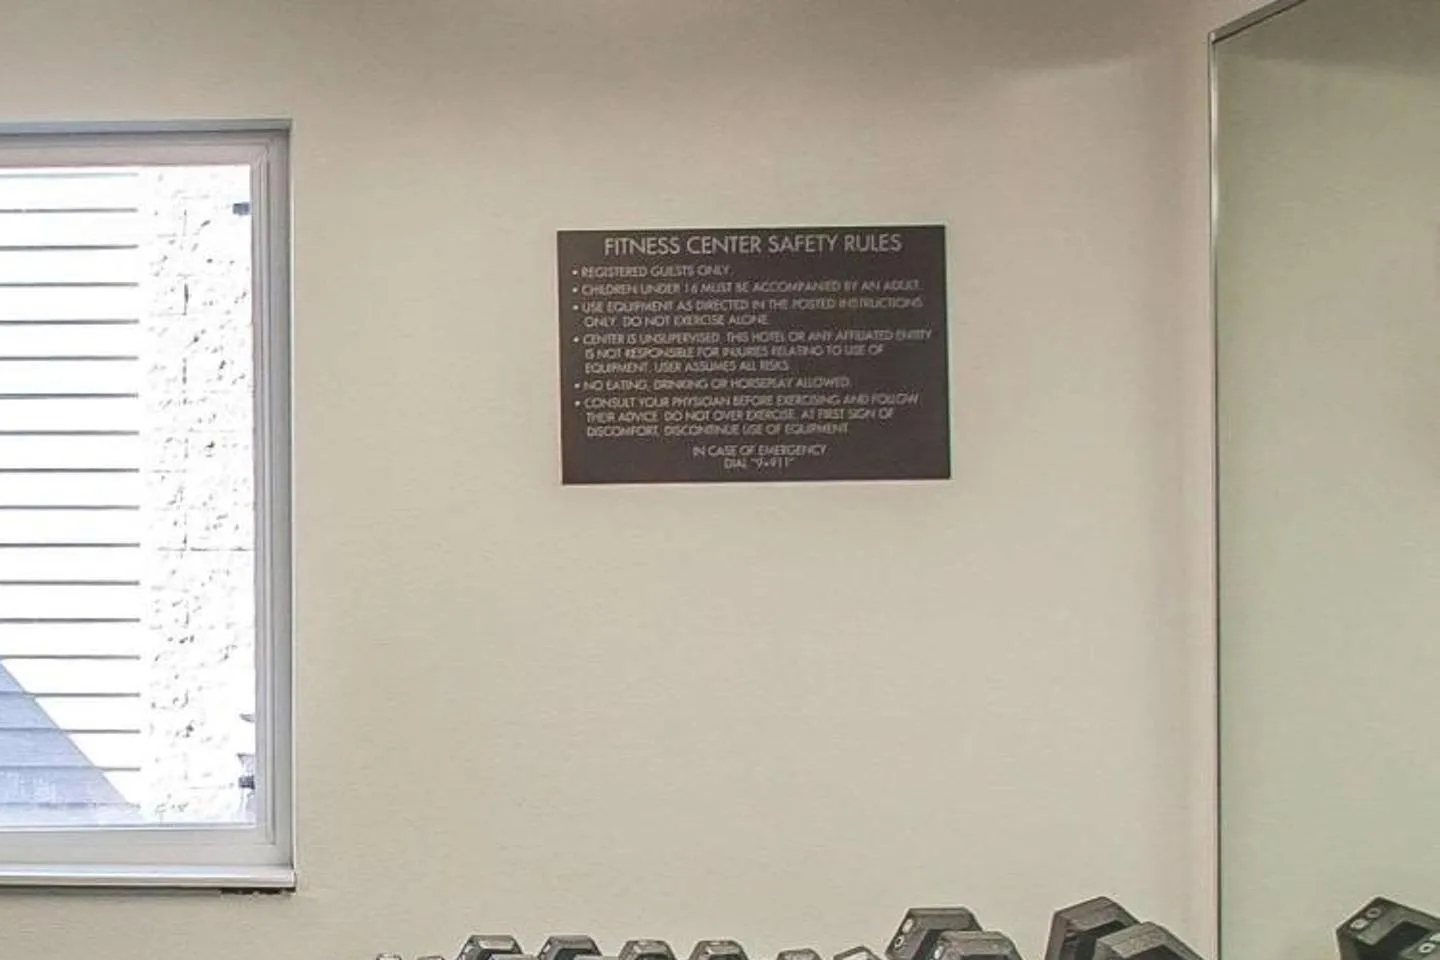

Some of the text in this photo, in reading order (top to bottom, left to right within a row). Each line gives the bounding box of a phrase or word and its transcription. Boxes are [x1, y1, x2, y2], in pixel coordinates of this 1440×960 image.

[604, 234, 902, 256] FITNESS CENTER SAFETY RULES
[581, 267, 646, 277] REGISTERED
[650, 265, 694, 276] GUESTS
[581, 284, 637, 295] CHILDREN
[641, 284, 680, 294] UNDER
[684, 283, 697, 293] 16
[701, 282, 732, 293] MUST
[737, 282, 749, 292] BE
[752, 281, 840, 292] ACCOMPANIED
[844, 281, 857, 291] BY
[862, 280, 880, 291] AN
[582, 297, 923, 313] USE EQUIPMENT AS DIRECTED IN THE POSTED INSTRUCTIONS
[623, 316, 642, 326] DO
[645, 315, 671, 326] NOT
[674, 315, 724, 325] EXERCISE
[583, 334, 624, 344] CENTER
[626, 334, 636, 344] IS
[727, 332, 749, 342] THIS
[752, 331, 785, 342] HOTEL
[789, 331, 804, 341] OR
[808, 330, 832, 341] ANY
[836, 330, 893, 341] AFFILIATED
[896, 329, 932, 340] ENTITY
[585, 344, 883, 359] IS NOT RESPONSIBLE FOR INJURIES RELATING TO USE OF
[655, 362, 681, 373] USER
[685, 361, 737, 372] ASSUMES
[739, 361, 756, 371] ALL
[583, 380, 603, 391] NO
[654, 379, 708, 390] DRINKING
[711, 379, 728, 389] OR
[731, 377, 792, 389] HORSEPLAY
[584, 393, 919, 408] CONSULT YOUR PHYSICIAN BEFORE EXERCISING AND FOLLOW
[586, 412, 615, 423] THEIR
[664, 411, 682, 421] DO
[686, 411, 710, 421] NOT
[712, 410, 743, 421] OVER
[801, 409, 815, 419] AT
[818, 408, 844, 419] FIRST
[848, 408, 875, 419] SIGN
[879, 407, 894, 418] OF
[664, 424, 740, 436] DISCONTINUE
[743, 424, 763, 435] USE
[766, 423, 781, 434] OF
[693, 444, 827, 456] IN CASE OF EMERGENCY
[724, 457, 746, 468] DIAL
